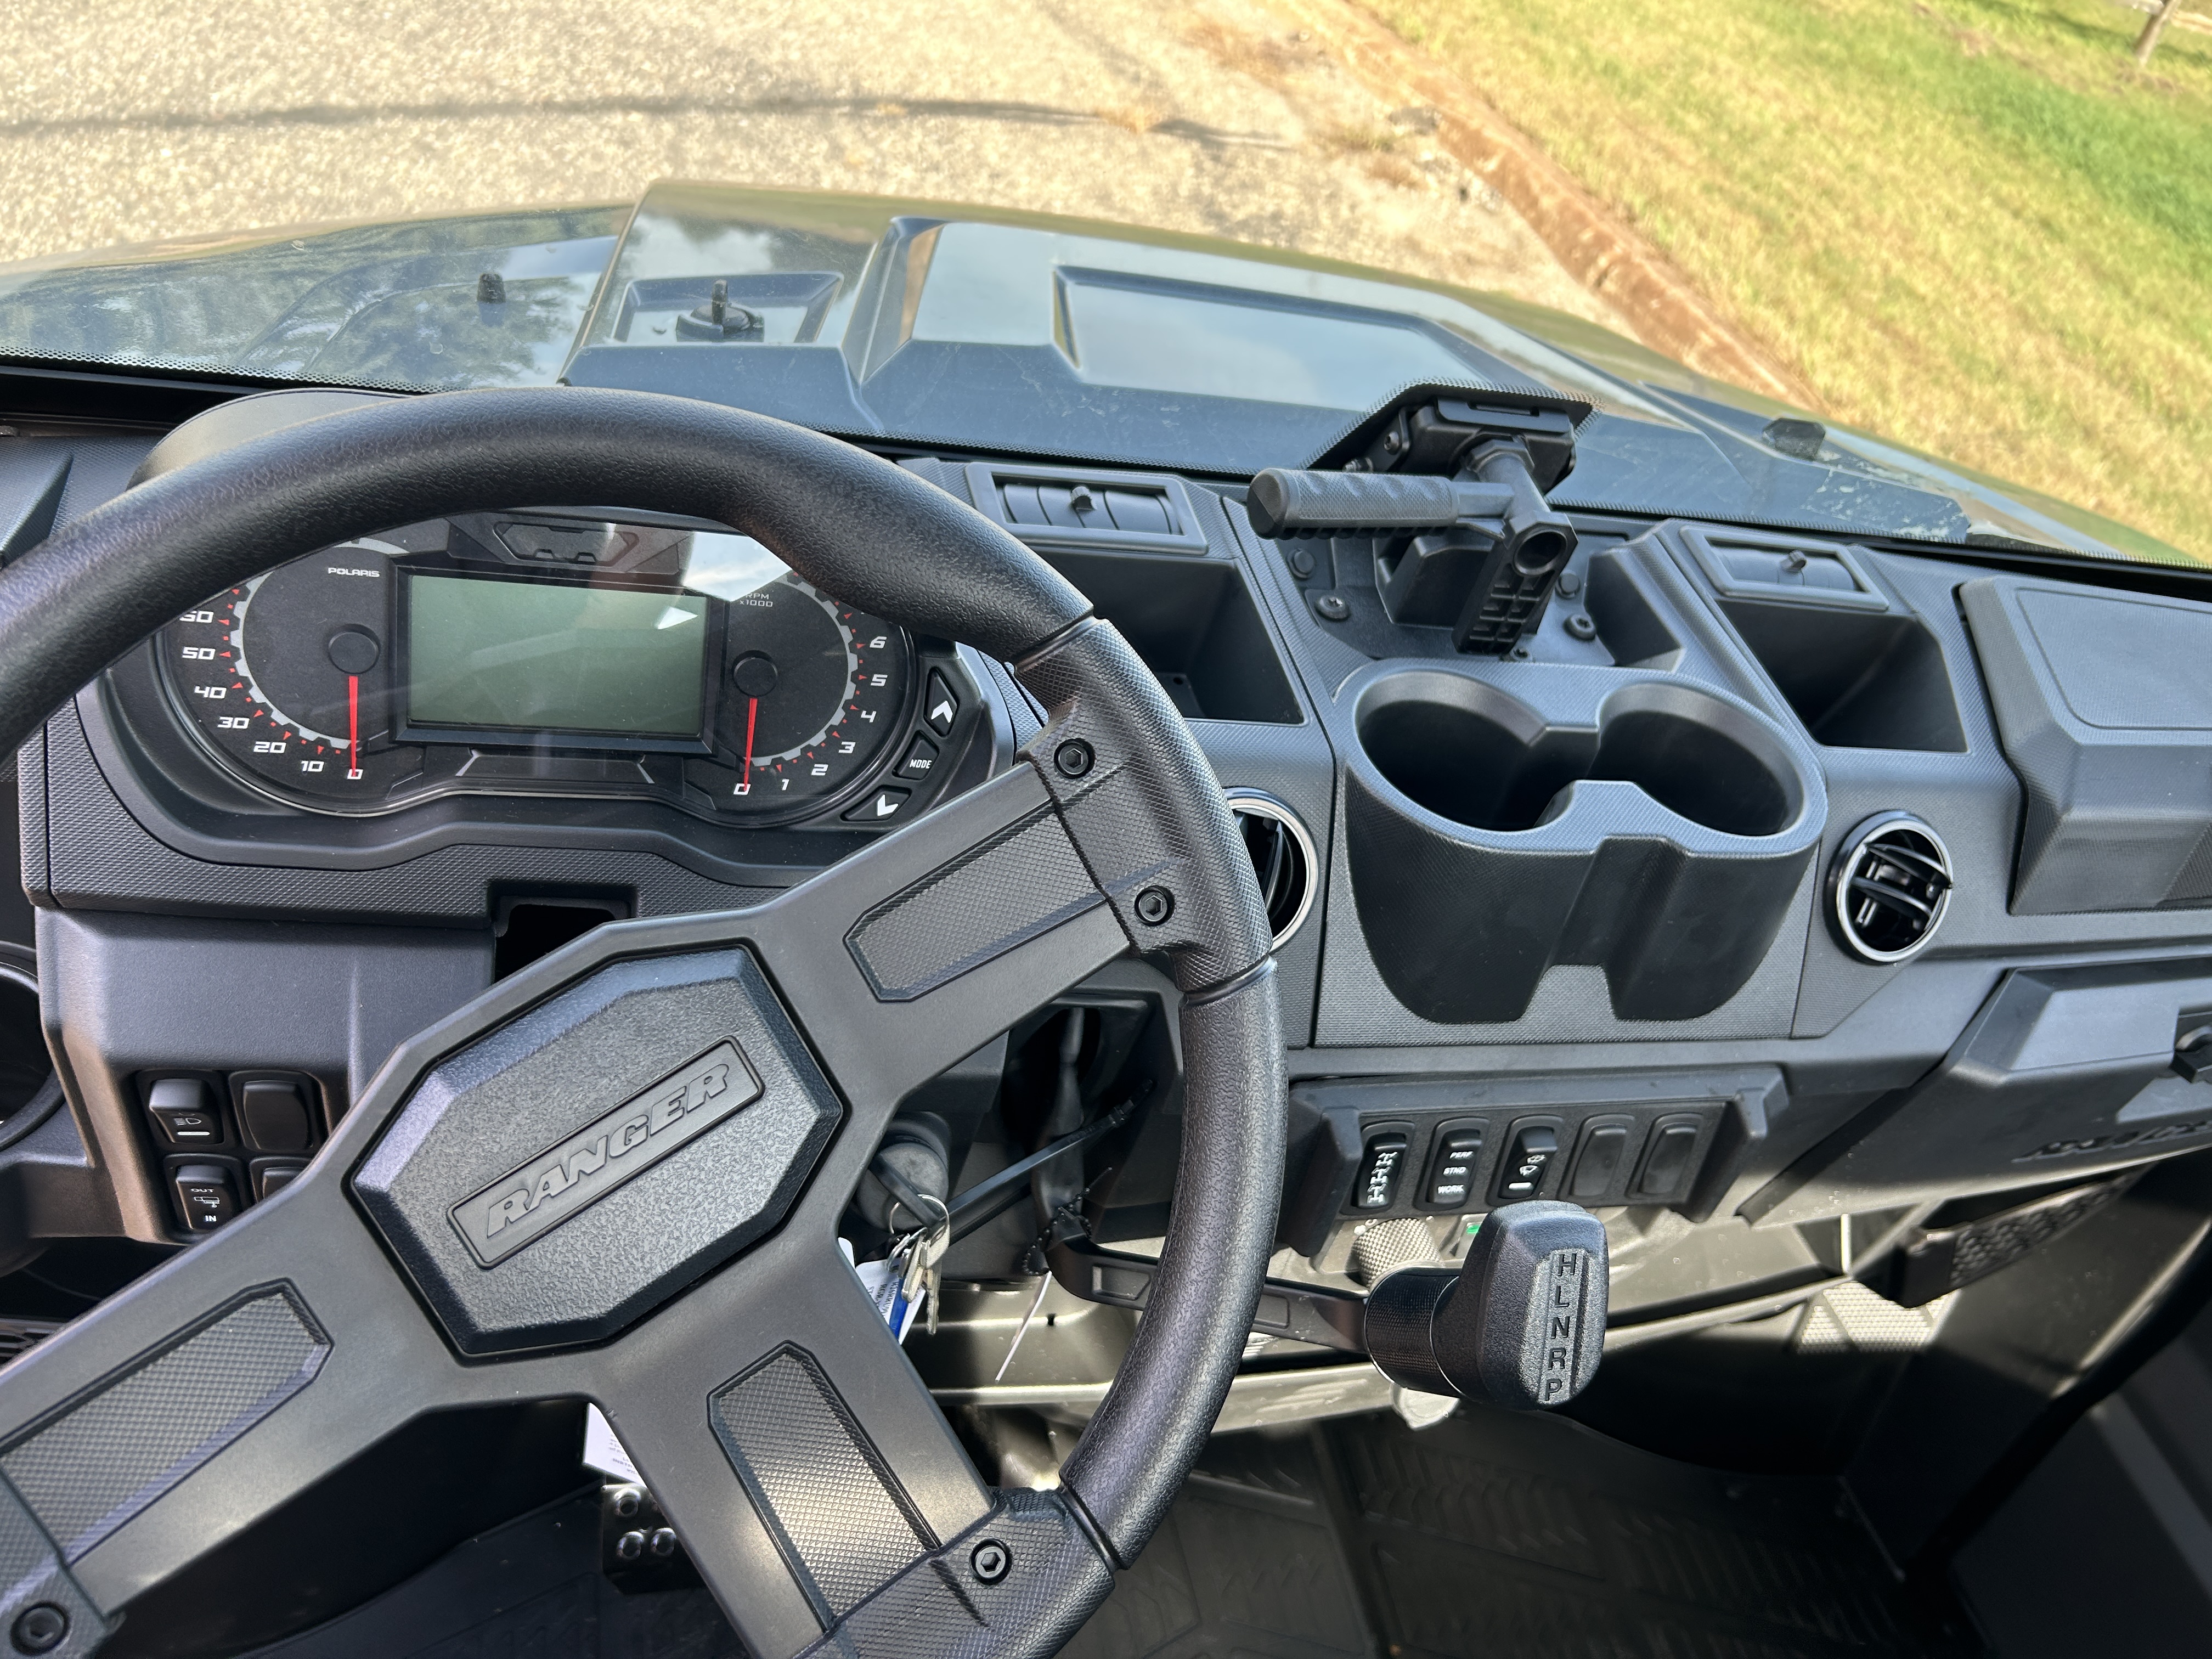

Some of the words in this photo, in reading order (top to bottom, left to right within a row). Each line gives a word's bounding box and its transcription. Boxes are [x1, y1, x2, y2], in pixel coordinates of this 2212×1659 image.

[328, 567, 380, 578] POLARIS
[870, 636, 887, 648] 6
[182, 647, 216, 660] 50
[870, 674, 888, 686] 5
[194, 686, 227, 699] 40
[217, 716, 250, 729] 30
[860, 710, 877, 723] 4
[253, 741, 286, 754] 20
[838, 742, 856, 754] 3
[300, 760, 324, 772] 10
[811, 764, 829, 776] 2
[909, 759, 932, 769] MODE
[347, 769, 364, 780] 0
[733, 783, 751, 795] 0
[782, 778, 789, 791] 1
[487, 1063, 729, 1238] RANGER
[1443, 1166, 1467, 1175] STND
[1438, 1185, 1465, 1194] WORK
[1558, 1253, 1577, 1276] H
[1555, 1285, 1569, 1307] L
[1551, 1316, 1570, 1339] N
[1547, 1347, 1567, 1370] R
[1544, 1378, 1562, 1401] P
